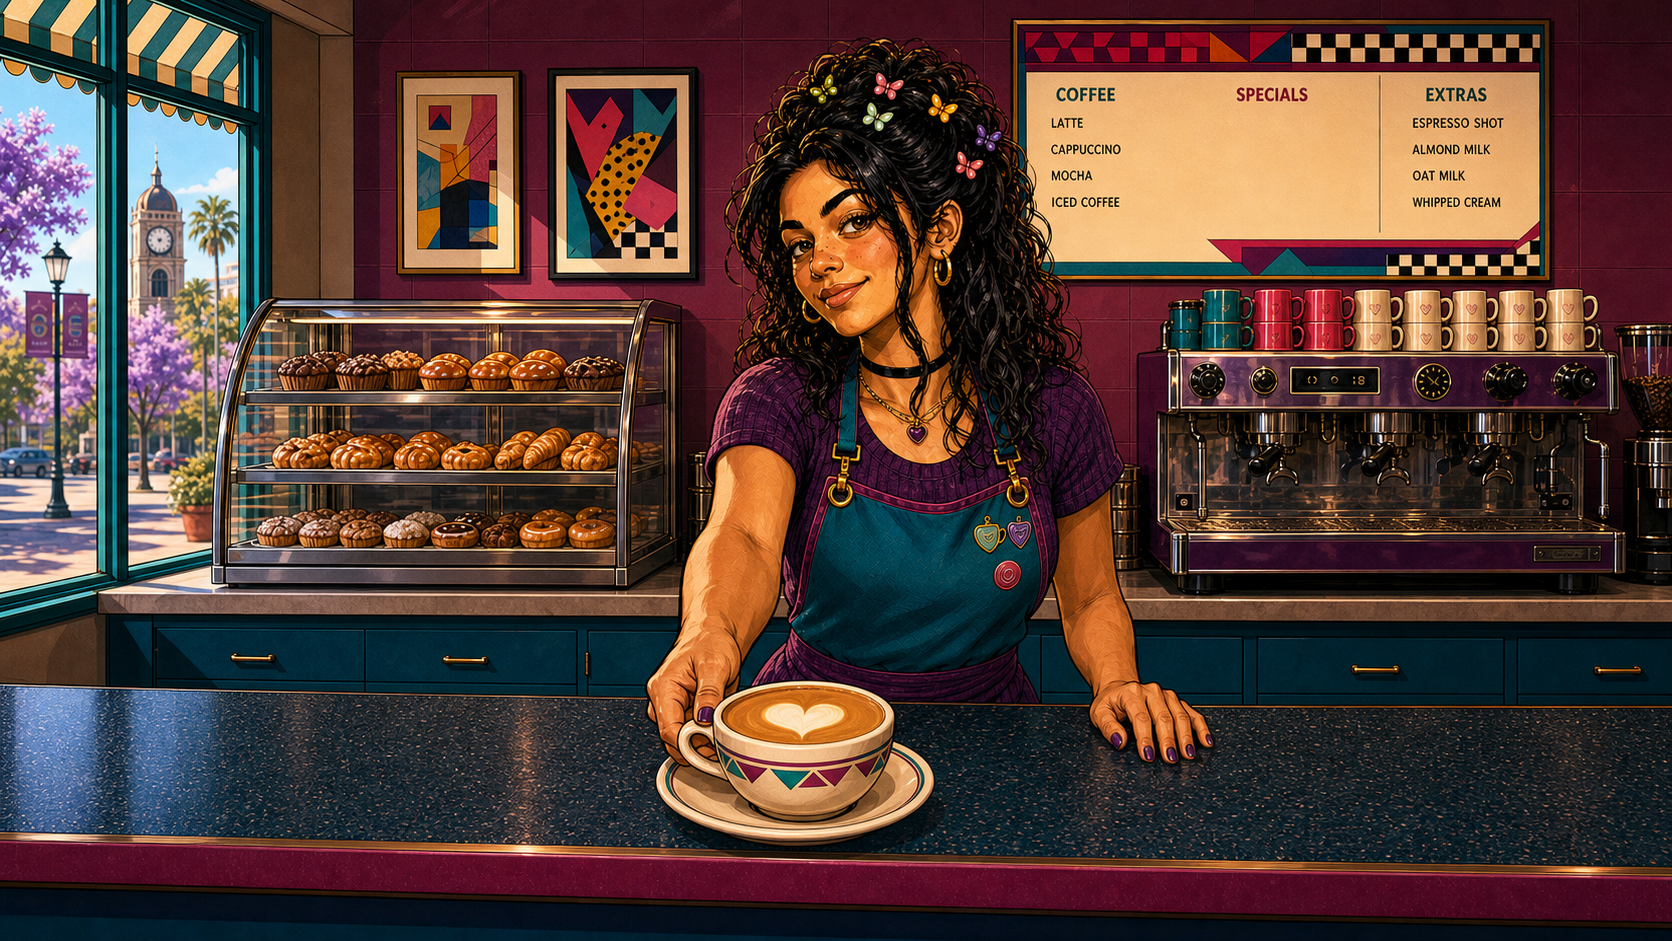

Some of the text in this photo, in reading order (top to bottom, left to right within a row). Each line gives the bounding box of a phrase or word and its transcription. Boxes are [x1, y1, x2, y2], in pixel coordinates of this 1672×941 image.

[1056, 87, 1116, 103] COFFEE
[1236, 87, 1309, 103] SPECIALS
[1425, 87, 1488, 103] EXTRAS
[1051, 117, 1084, 129] LATTE
[1412, 117, 1505, 129] ESPRESSO SHOT
[1051, 143, 1122, 155] CAPPUCCINO
[1412, 143, 1491, 155] ALMOND MILK
[1051, 169, 1093, 182] MOCHA
[1412, 169, 1466, 182] OAT MILK
[1051, 196, 1120, 208] ICED COFFEE
[1412, 196, 1502, 208] WHIPPED CREAM
